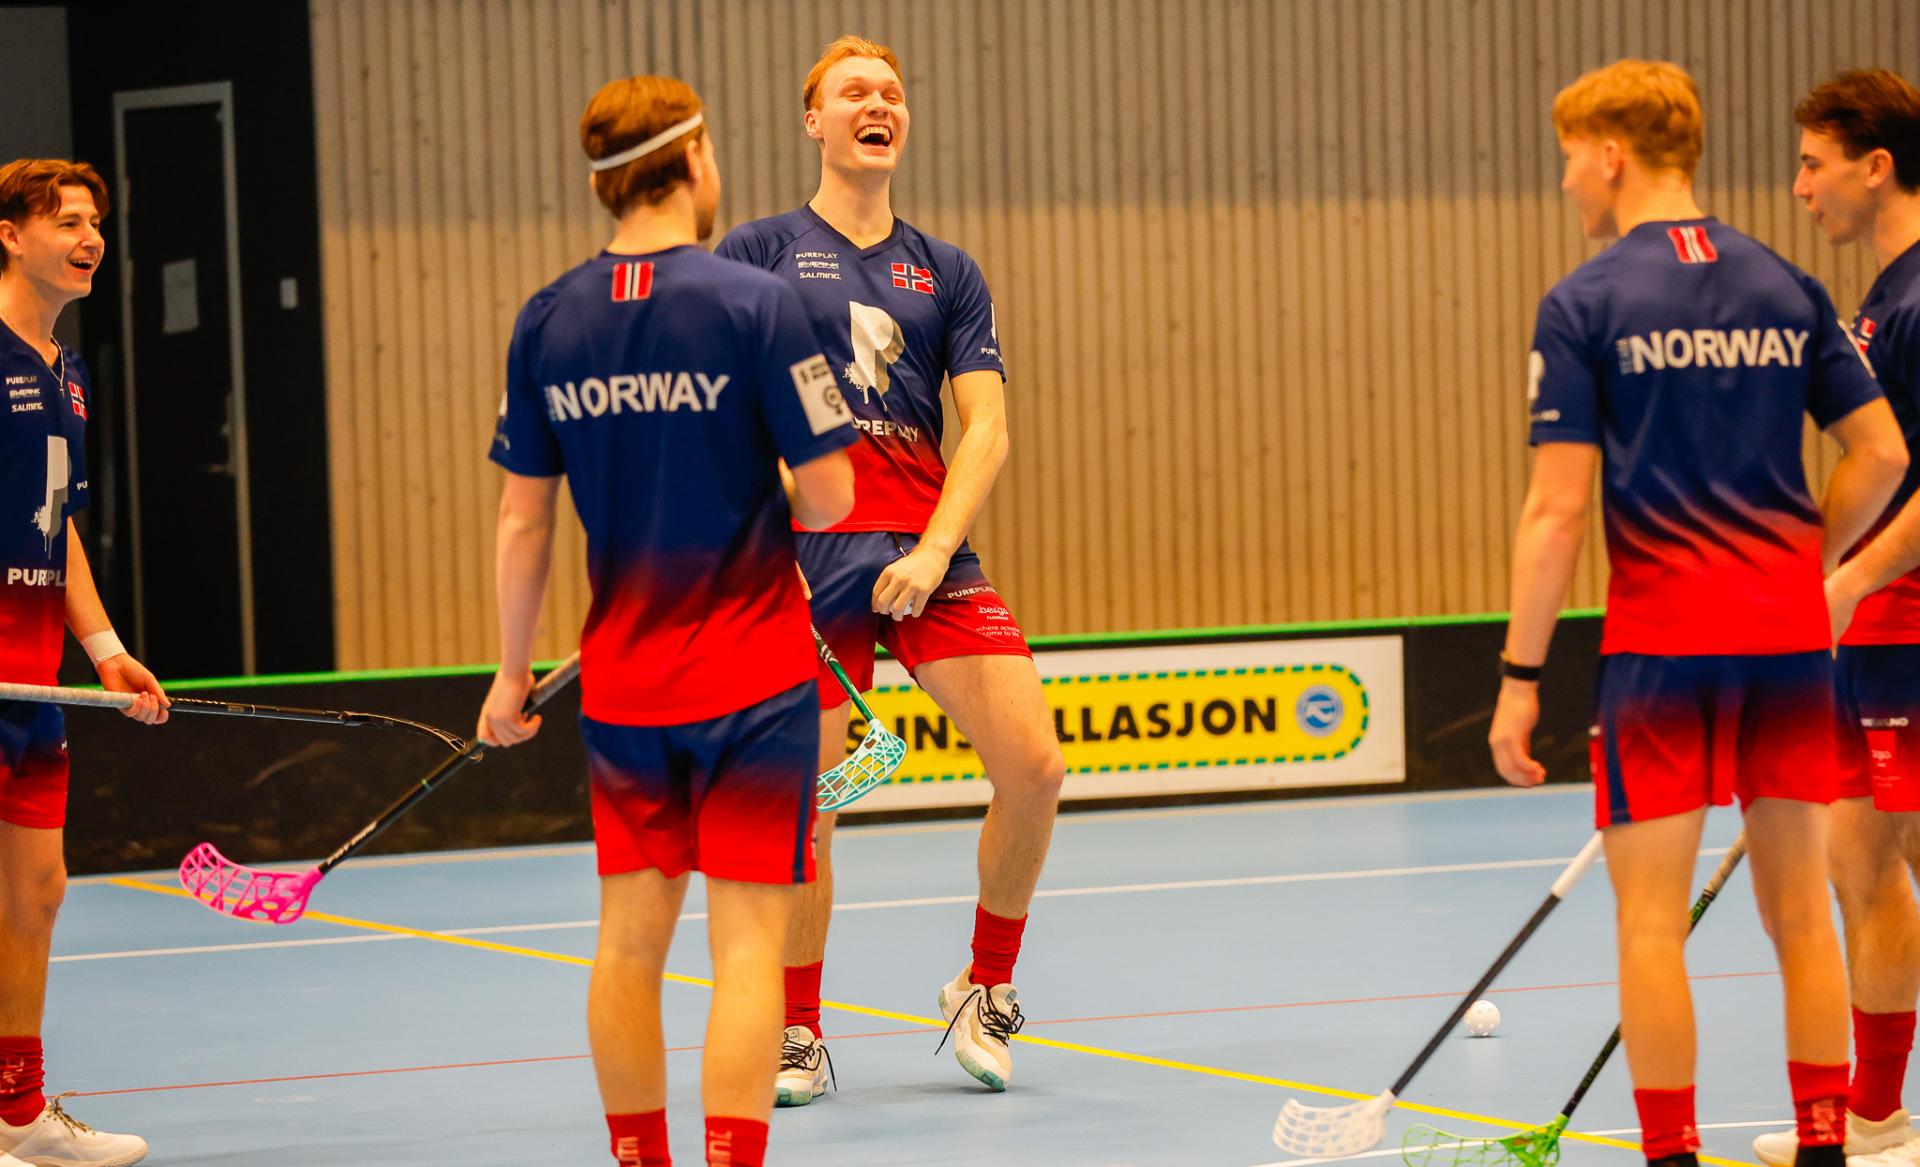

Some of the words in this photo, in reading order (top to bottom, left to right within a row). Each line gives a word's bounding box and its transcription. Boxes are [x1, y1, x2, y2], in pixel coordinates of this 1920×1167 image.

[1631, 328, 1809, 373] NORWAY
[551, 371, 730, 422] NORWAY
[896, 697, 1277, 751] INLLASJON
